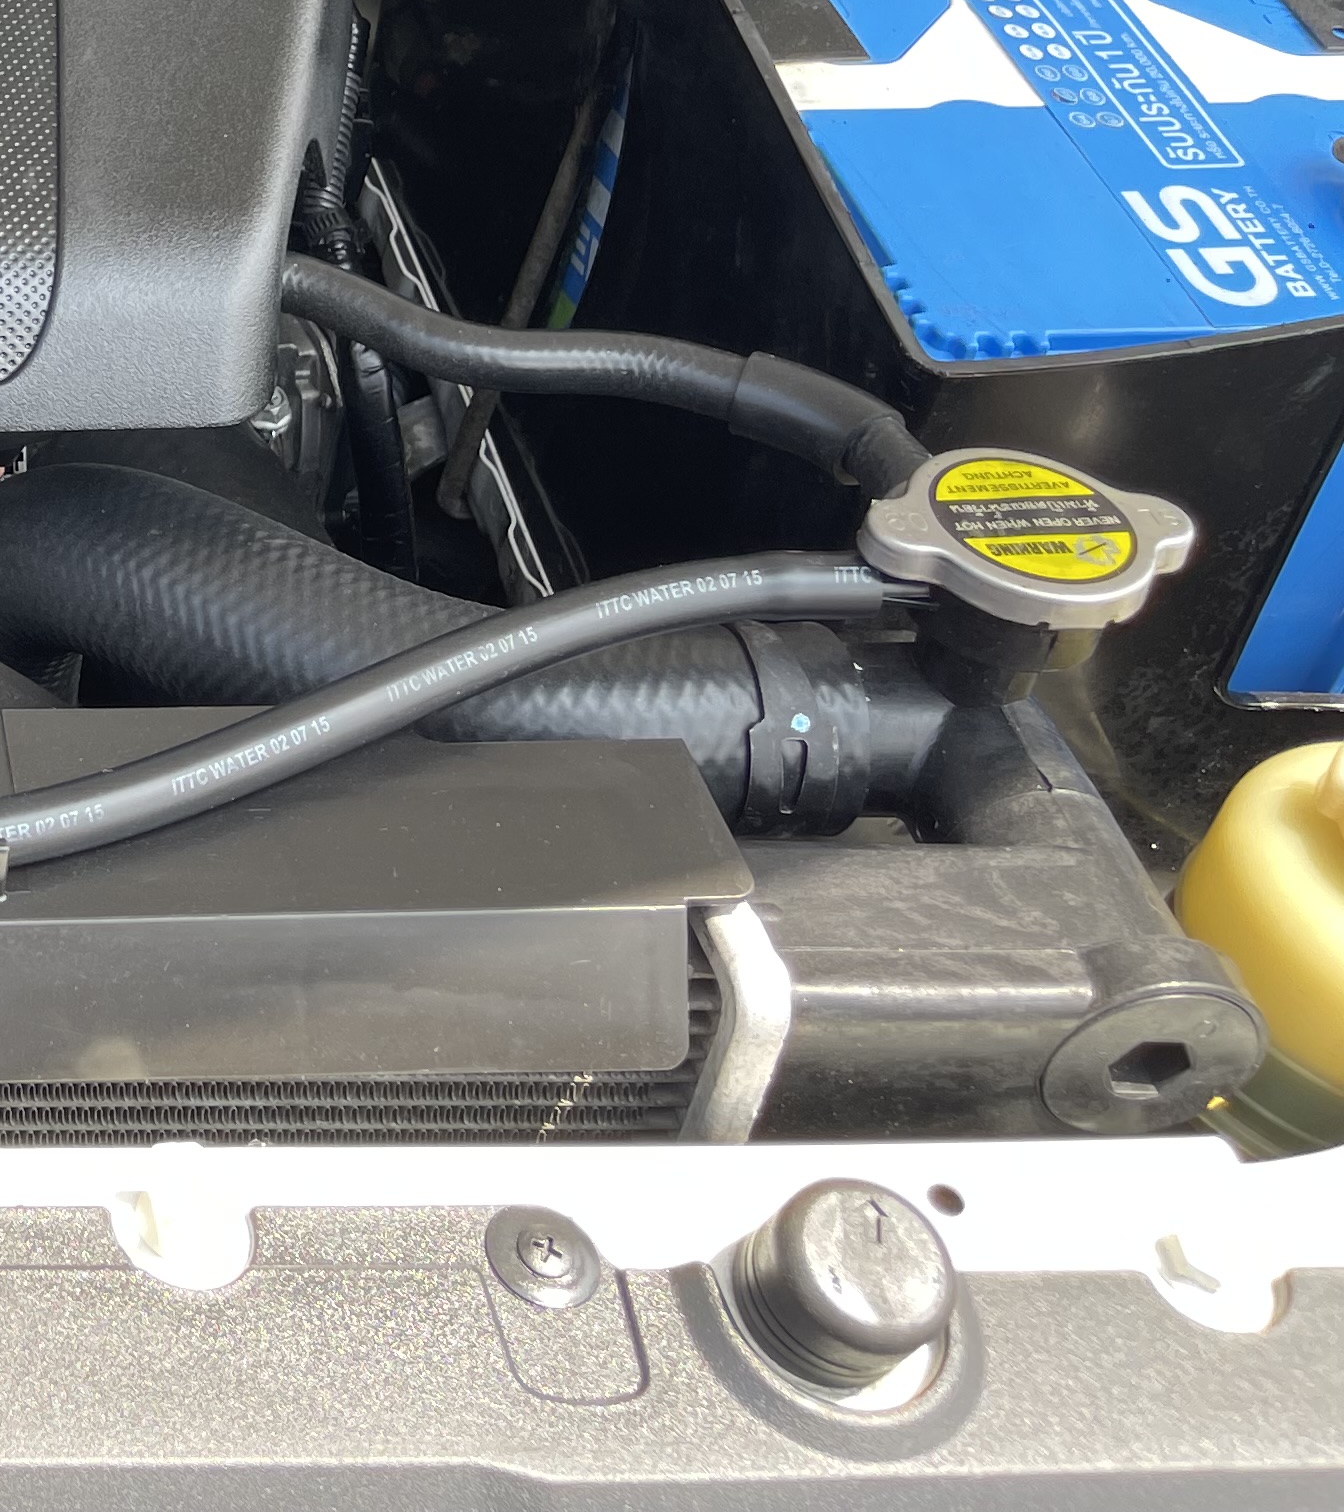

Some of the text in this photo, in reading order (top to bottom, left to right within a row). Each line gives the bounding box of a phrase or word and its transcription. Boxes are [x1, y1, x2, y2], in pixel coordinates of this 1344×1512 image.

[1094, 50, 1123, 60] 1
[1121, 185, 1278, 307] GS
[1211, 188, 1317, 297] BATTERY
[947, 481, 1069, 493] AVERTISSEMENT
[963, 471, 1032, 480] ACHTUNG
[955, 515, 1121, 531] NEVER OPEN WHEN HOT
[985, 541, 1073, 556] WARNING
[634, 580, 693, 607] WATER
[696, 576, 716, 593] 02
[719, 573, 737, 589] 07
[743, 570, 762, 585] 15
[423, 651, 478, 684] WATER
[480, 643, 499, 661] 02
[499, 634, 514, 653] 07
[518, 626, 537, 645] 15
[209, 744, 269, 779] WATER
[271, 734, 289, 754] 02
[291, 726, 307, 746] 07
[311, 716, 330, 736] 15
[35, 818, 55, 836] 02
[59, 811, 79, 831] 07
[85, 804, 106, 823] 15
